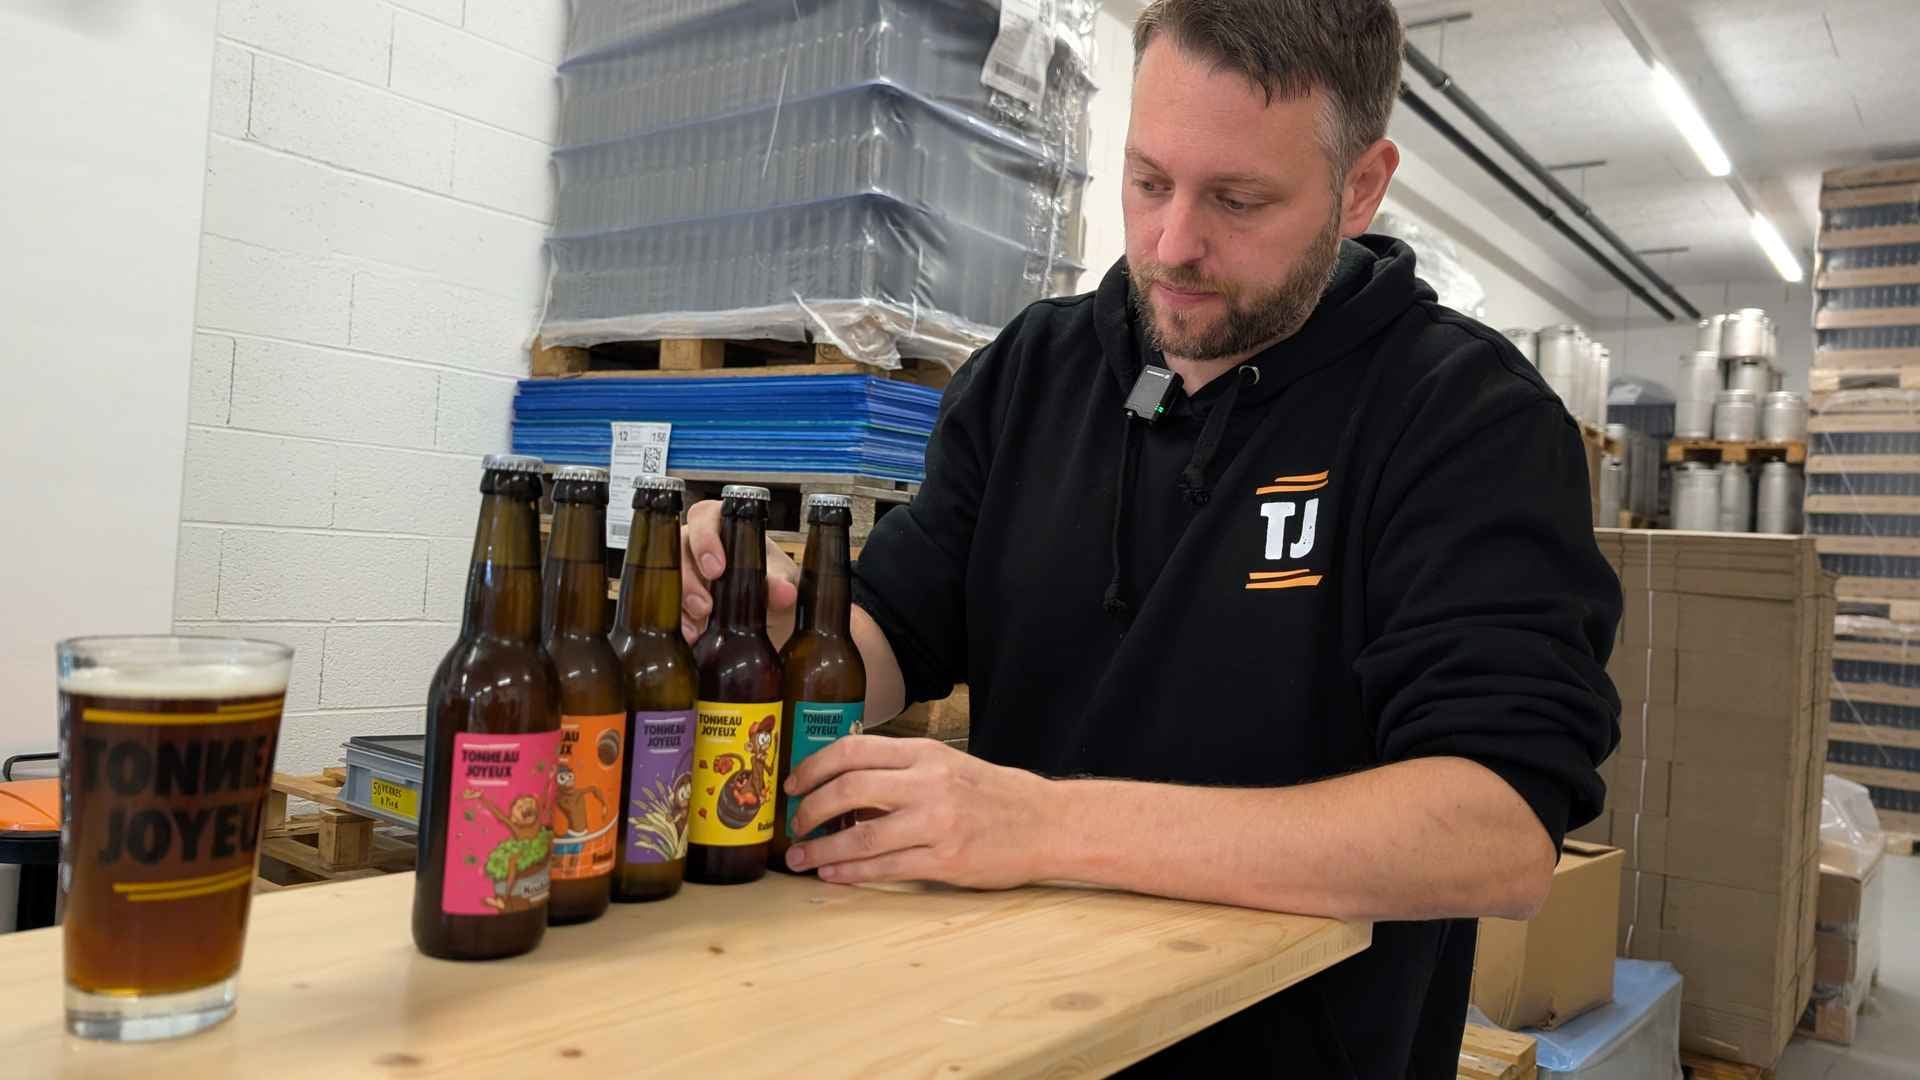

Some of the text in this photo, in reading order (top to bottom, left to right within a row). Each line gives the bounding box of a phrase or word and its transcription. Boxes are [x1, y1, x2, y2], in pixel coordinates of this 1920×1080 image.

[1260, 497, 1320, 560] TJ
[698, 713, 742, 727] TONNEAU
[701, 725, 737, 737] JOYEUX
[81, 736, 268, 796] TONNE
[465, 764, 513, 778] JOYEUX
